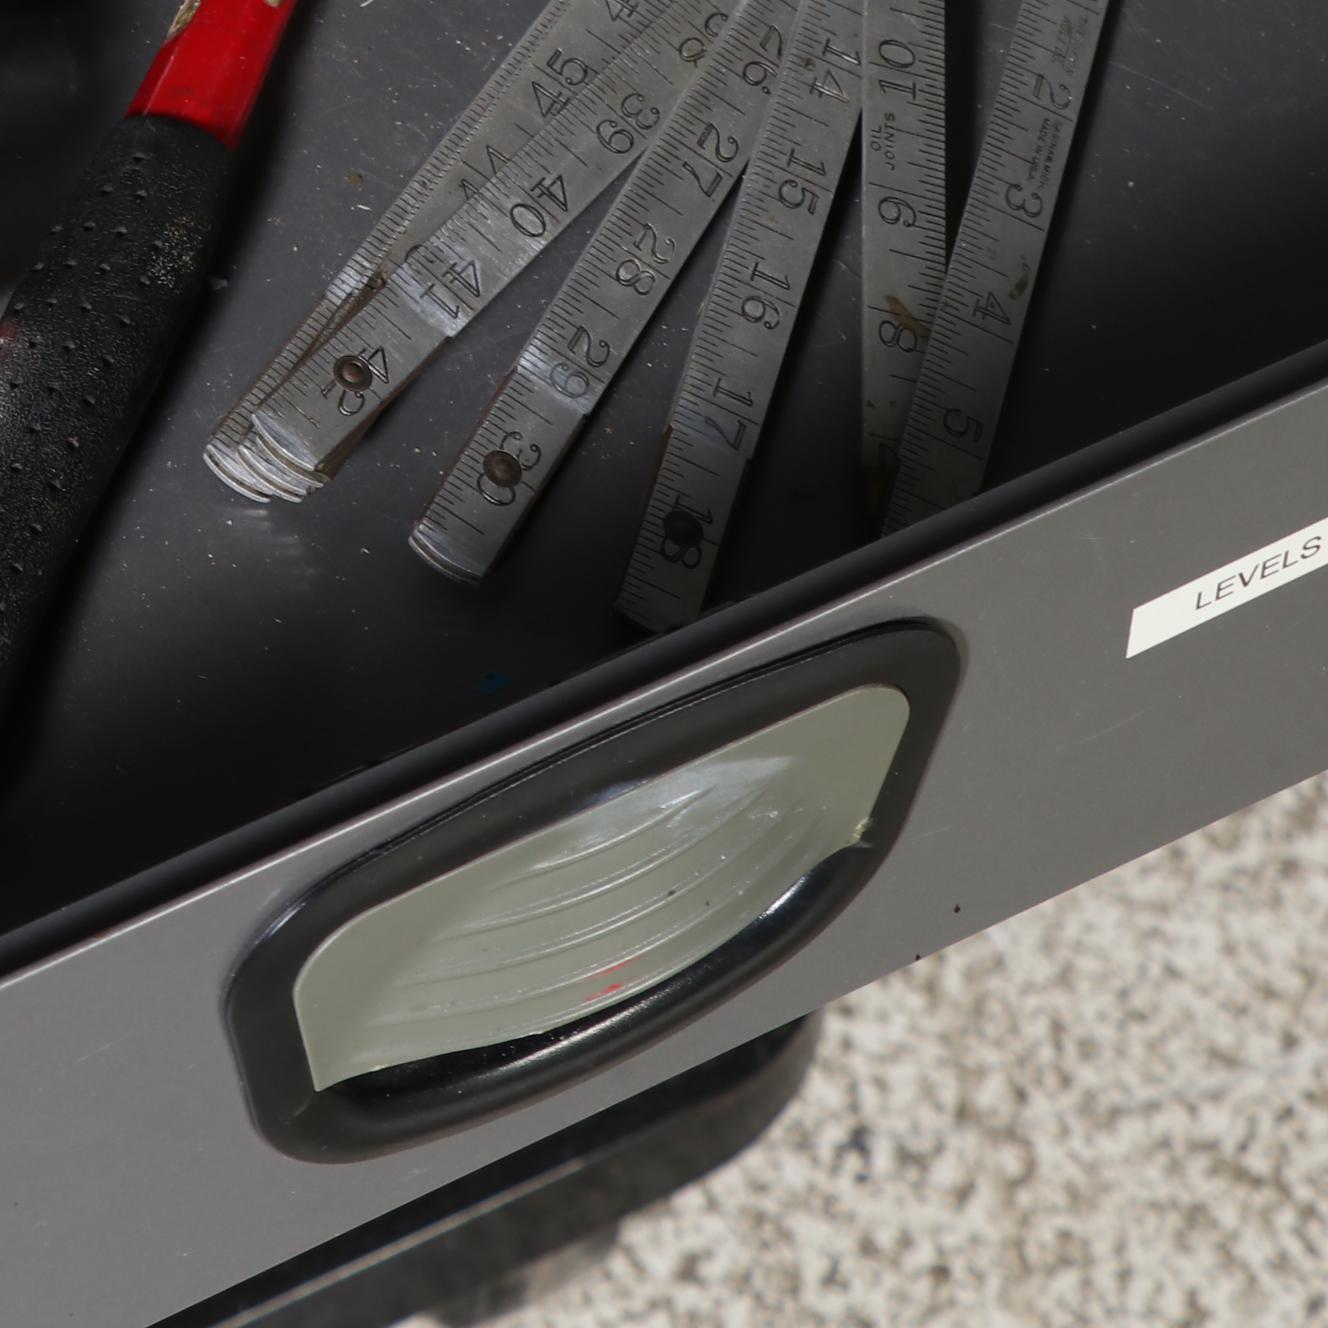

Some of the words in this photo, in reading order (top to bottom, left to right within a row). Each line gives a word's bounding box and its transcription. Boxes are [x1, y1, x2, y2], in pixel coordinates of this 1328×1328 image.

[530, 49, 589, 117] 45
[810, 38, 862, 104] 14
[878, 40, 918, 100] 10
[1033, 74, 1073, 110] 2
[683, 124, 740, 197] 27
[870, 125, 883, 151] OIL
[883, 112, 896, 171] JOINTS
[510, 173, 570, 238] 40
[777, 148, 826, 215] 15
[1005, 184, 1044, 218] 3
[419, 260, 481, 319] 41
[616, 223, 676, 296] 28
[740, 262, 792, 331] 16
[971, 292, 1012, 327] 4
[550, 326, 610, 399] 29
[878, 319, 918, 352] 8
[703, 378, 754, 451] 17
[943, 407, 981, 442] 5
[1195, 536, 1322, 610] LEVELS
